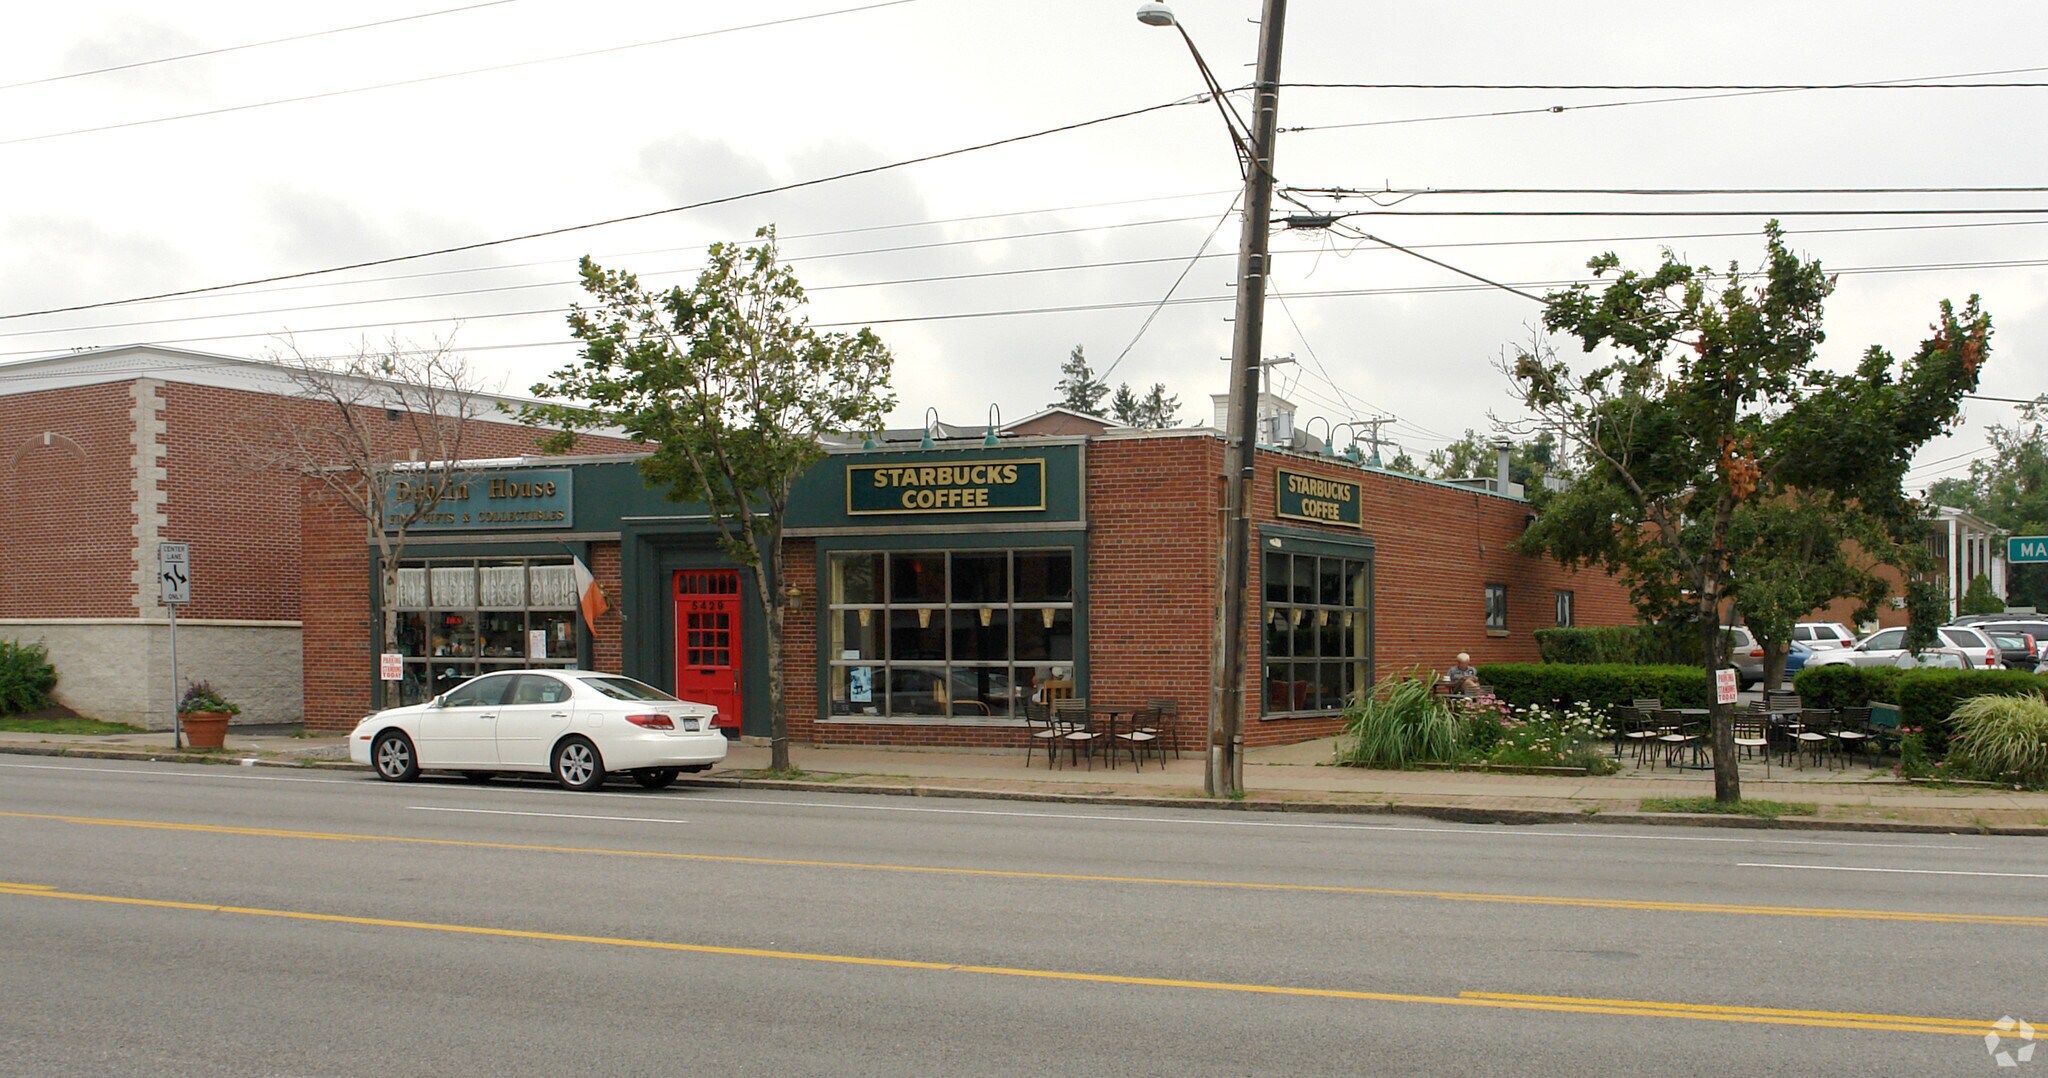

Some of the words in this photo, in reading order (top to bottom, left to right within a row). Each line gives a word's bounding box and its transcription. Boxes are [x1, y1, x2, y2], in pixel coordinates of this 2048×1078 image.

[874, 465, 1018, 488] STARBUCKS
[489, 478, 557, 499] House
[902, 488, 989, 509] COFFEE
[1288, 475, 1351, 501] STARBUCKS
[389, 513, 418, 525] FIN
[423, 513, 455, 525] GIFTS
[462, 511, 470, 523] &
[478, 510, 564, 523] COLLECTIBLES
[1302, 498, 1339, 520] COFFEE
[2020, 542, 2048, 557] MA
[692, 600, 724, 610] 5429
[1719, 694, 1735, 702] TODAY
